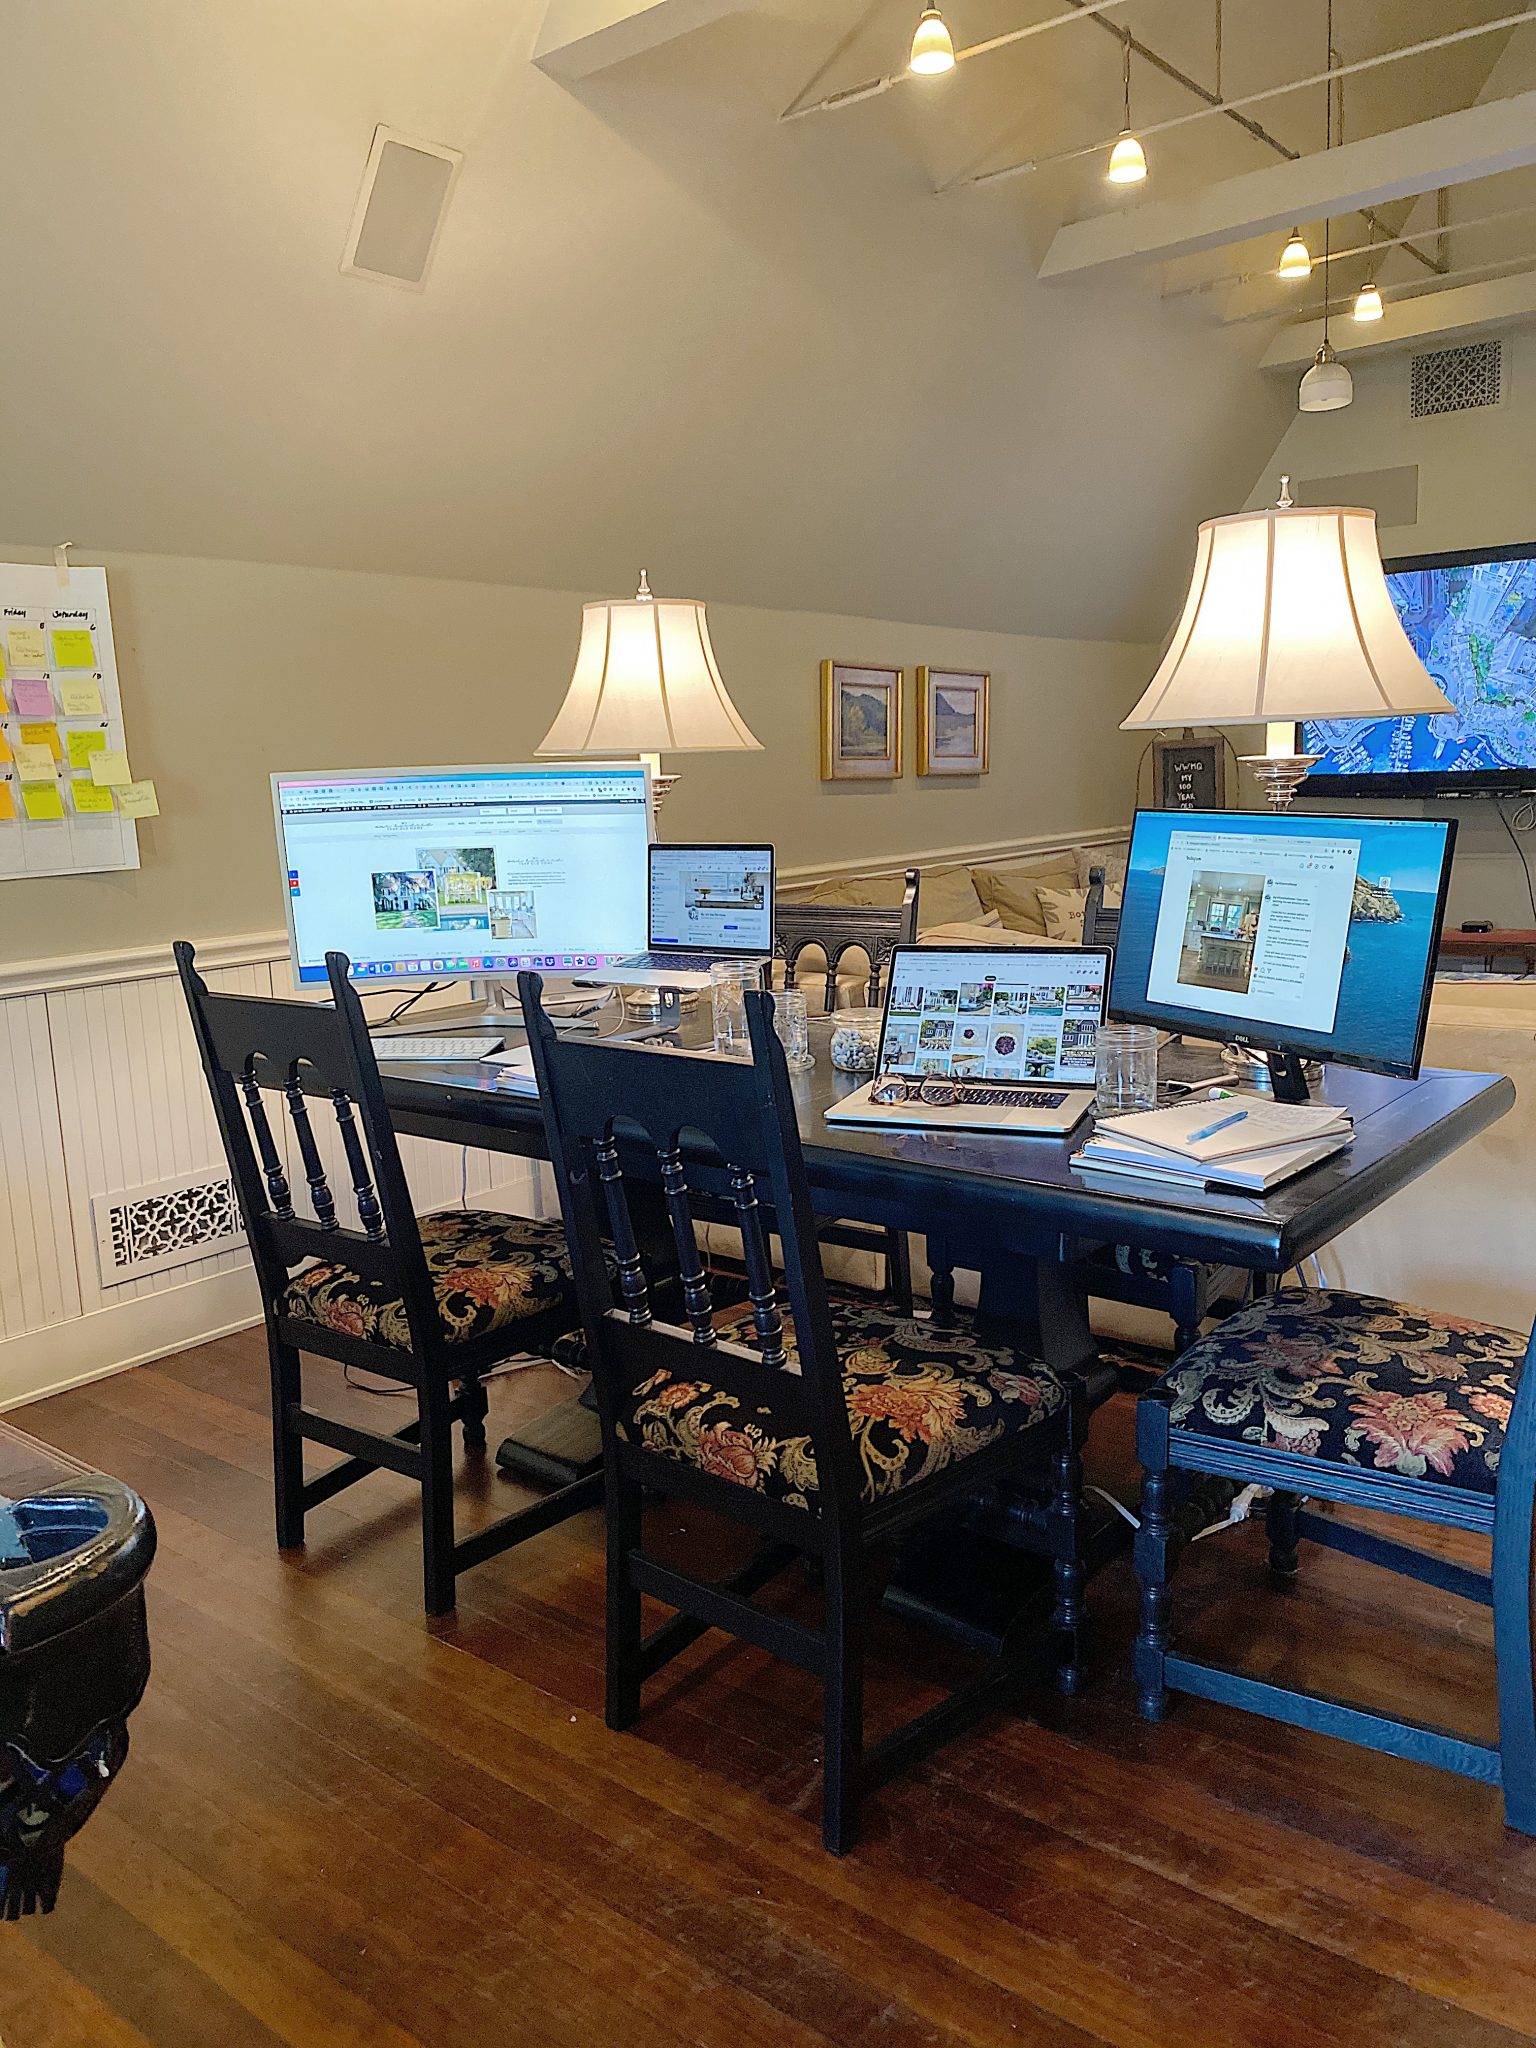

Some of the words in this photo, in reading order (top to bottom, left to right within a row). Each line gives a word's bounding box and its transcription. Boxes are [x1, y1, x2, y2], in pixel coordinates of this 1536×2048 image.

[4, 608, 27, 618] Friday
[52, 610, 88, 620] Saturday
[1181, 773, 1192, 782] MY
[1176, 792, 1196, 801] YEAR
[1235, 1035, 1249, 1044] DELL
